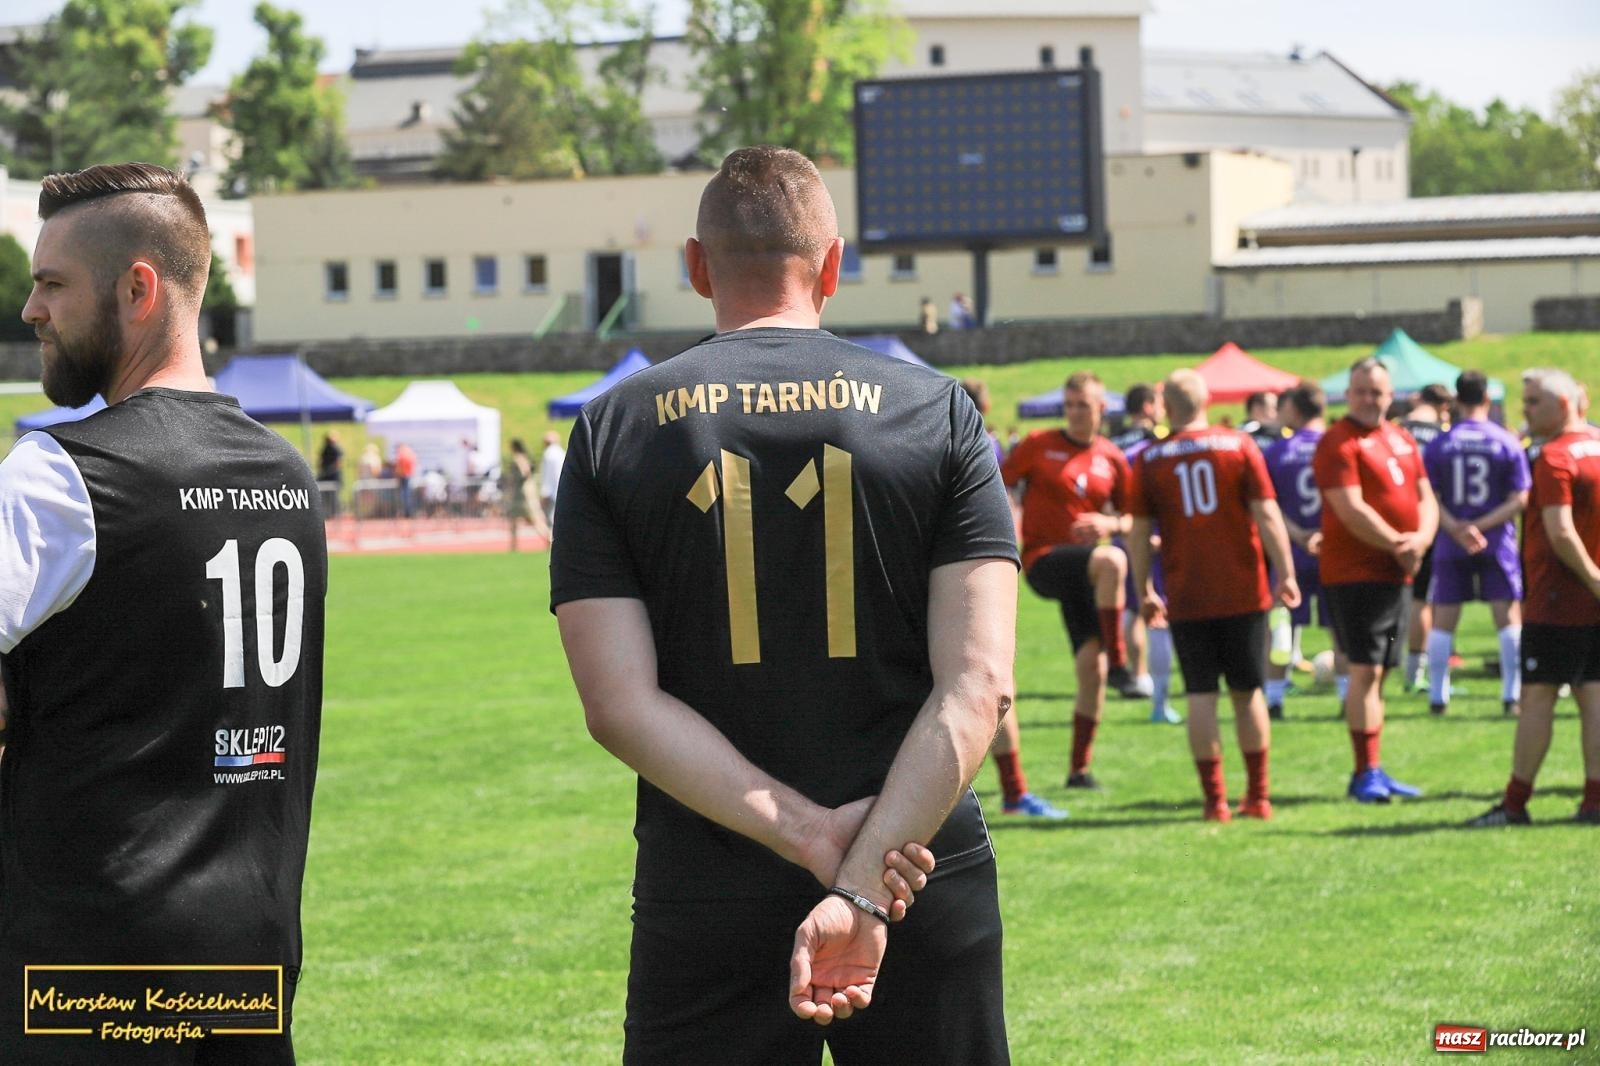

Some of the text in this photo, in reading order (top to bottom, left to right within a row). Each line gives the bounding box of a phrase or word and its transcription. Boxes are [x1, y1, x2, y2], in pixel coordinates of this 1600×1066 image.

[655, 370, 882, 426] KMP TARNÓW
[180, 484, 310, 510] KMP TARNÓW
[1173, 459, 1218, 518] 10
[1452, 455, 1491, 506] 13
[686, 443, 857, 664] 11
[206, 537, 305, 688] 10
[215, 725, 285, 755] SKLEP112
